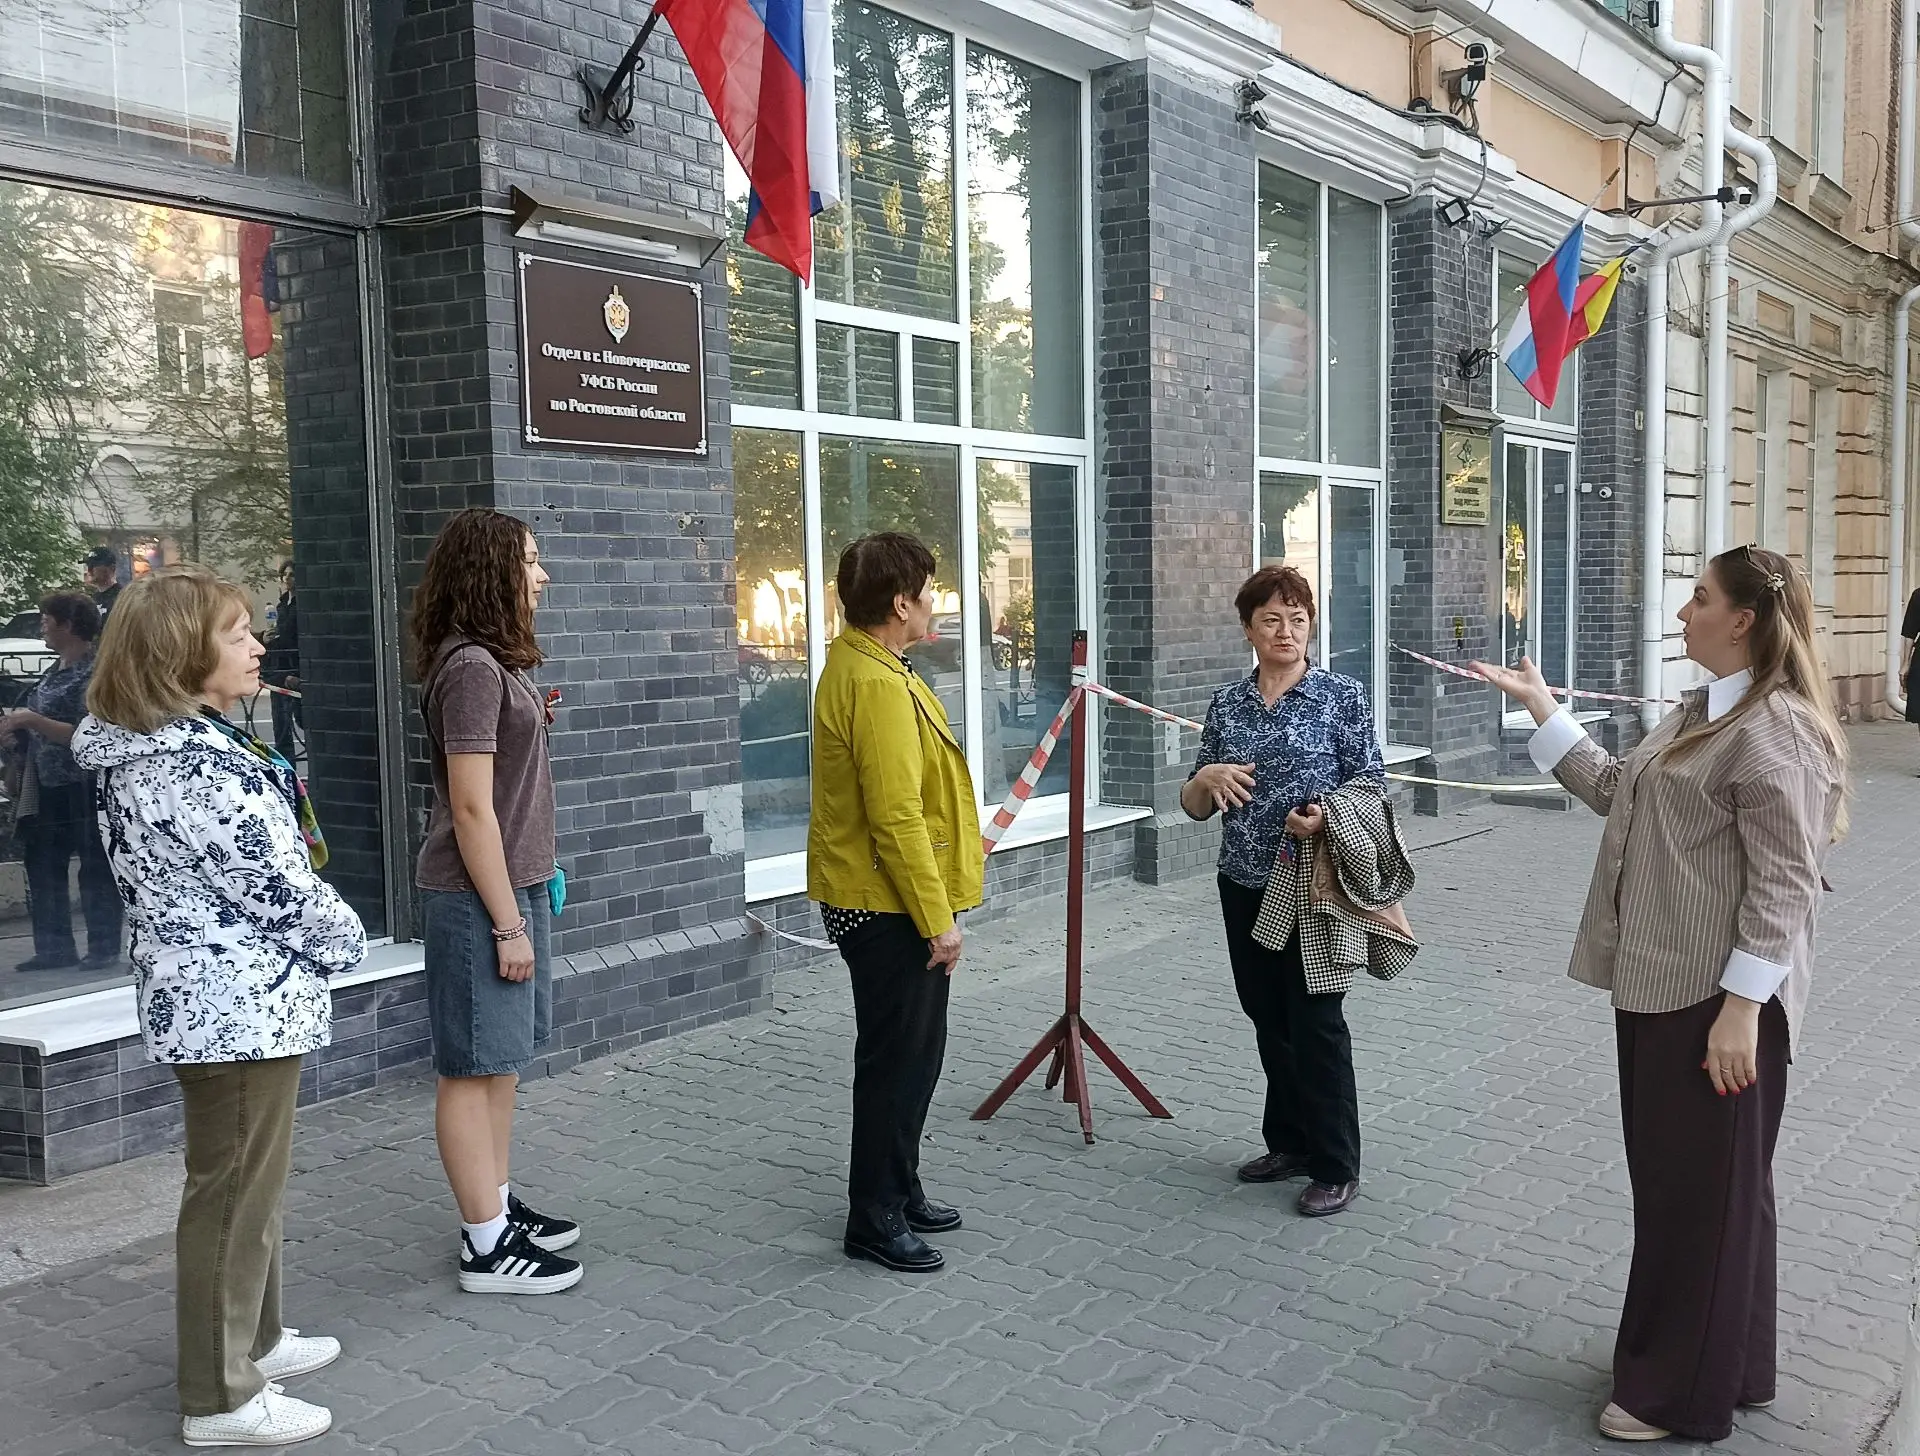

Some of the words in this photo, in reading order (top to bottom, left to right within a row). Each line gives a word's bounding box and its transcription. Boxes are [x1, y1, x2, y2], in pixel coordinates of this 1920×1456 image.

[541, 343, 582, 362] Отдел
[583, 352, 591, 361] в
[593, 353, 601, 362] г.
[602, 350, 691, 373] Новочеркасске
[579, 373, 616, 390] УФСБ
[616, 378, 659, 395] России
[549, 399, 567, 412] по
[568, 398, 639, 418] Ростовской
[640, 406, 687, 423] области
